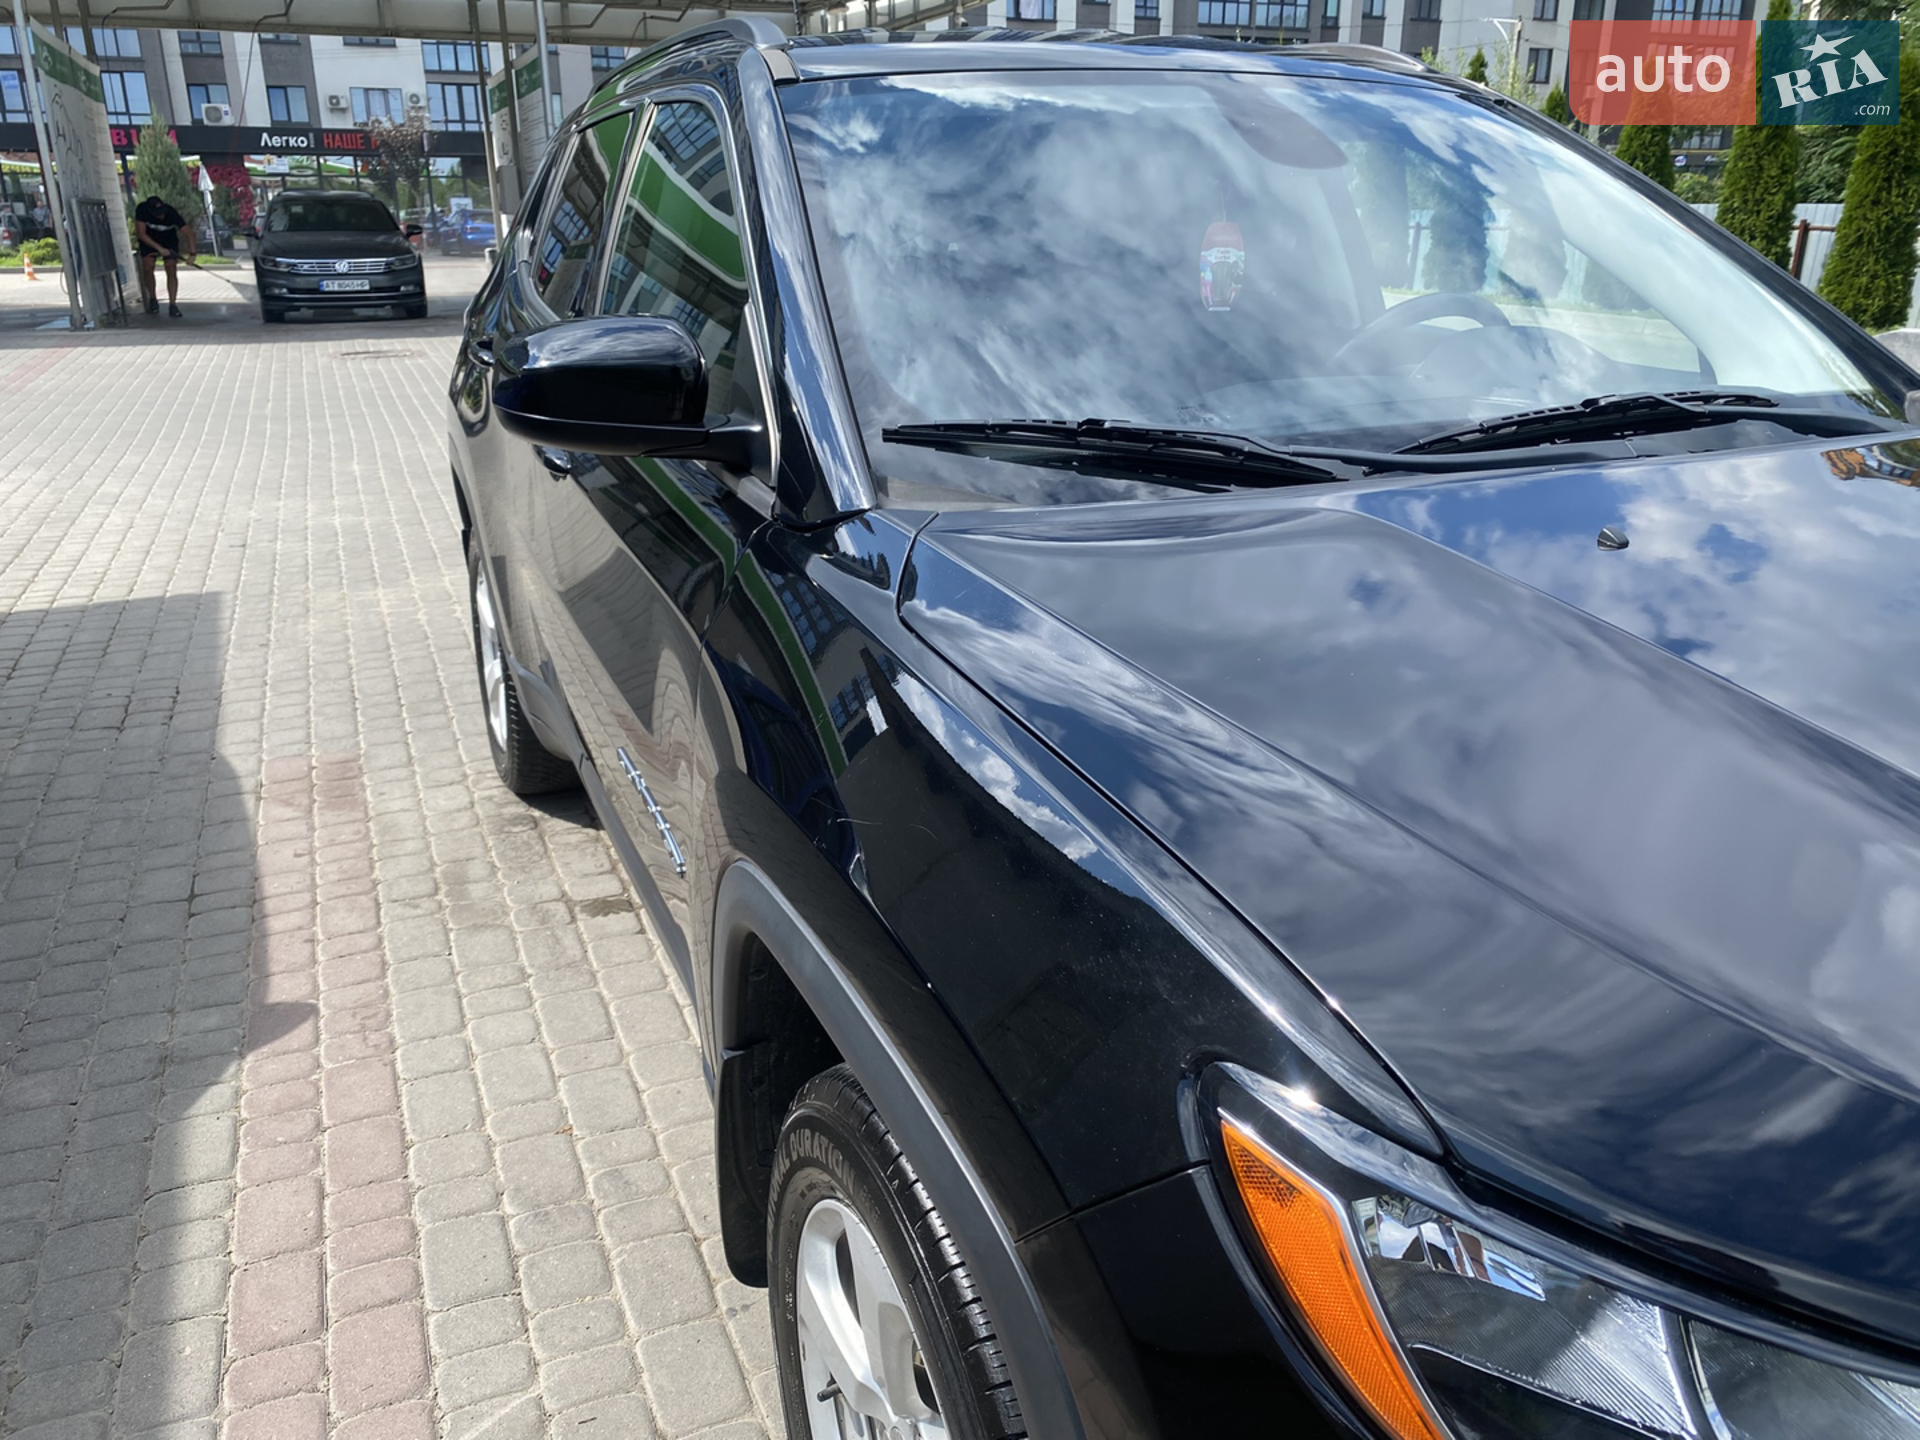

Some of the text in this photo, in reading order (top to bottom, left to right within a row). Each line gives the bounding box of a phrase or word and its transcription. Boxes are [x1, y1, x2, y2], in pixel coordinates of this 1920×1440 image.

[260, 131, 308, 148] Легко
[322, 132, 367, 150] НАШЕ
[789, 1128, 857, 1195] DURATION
